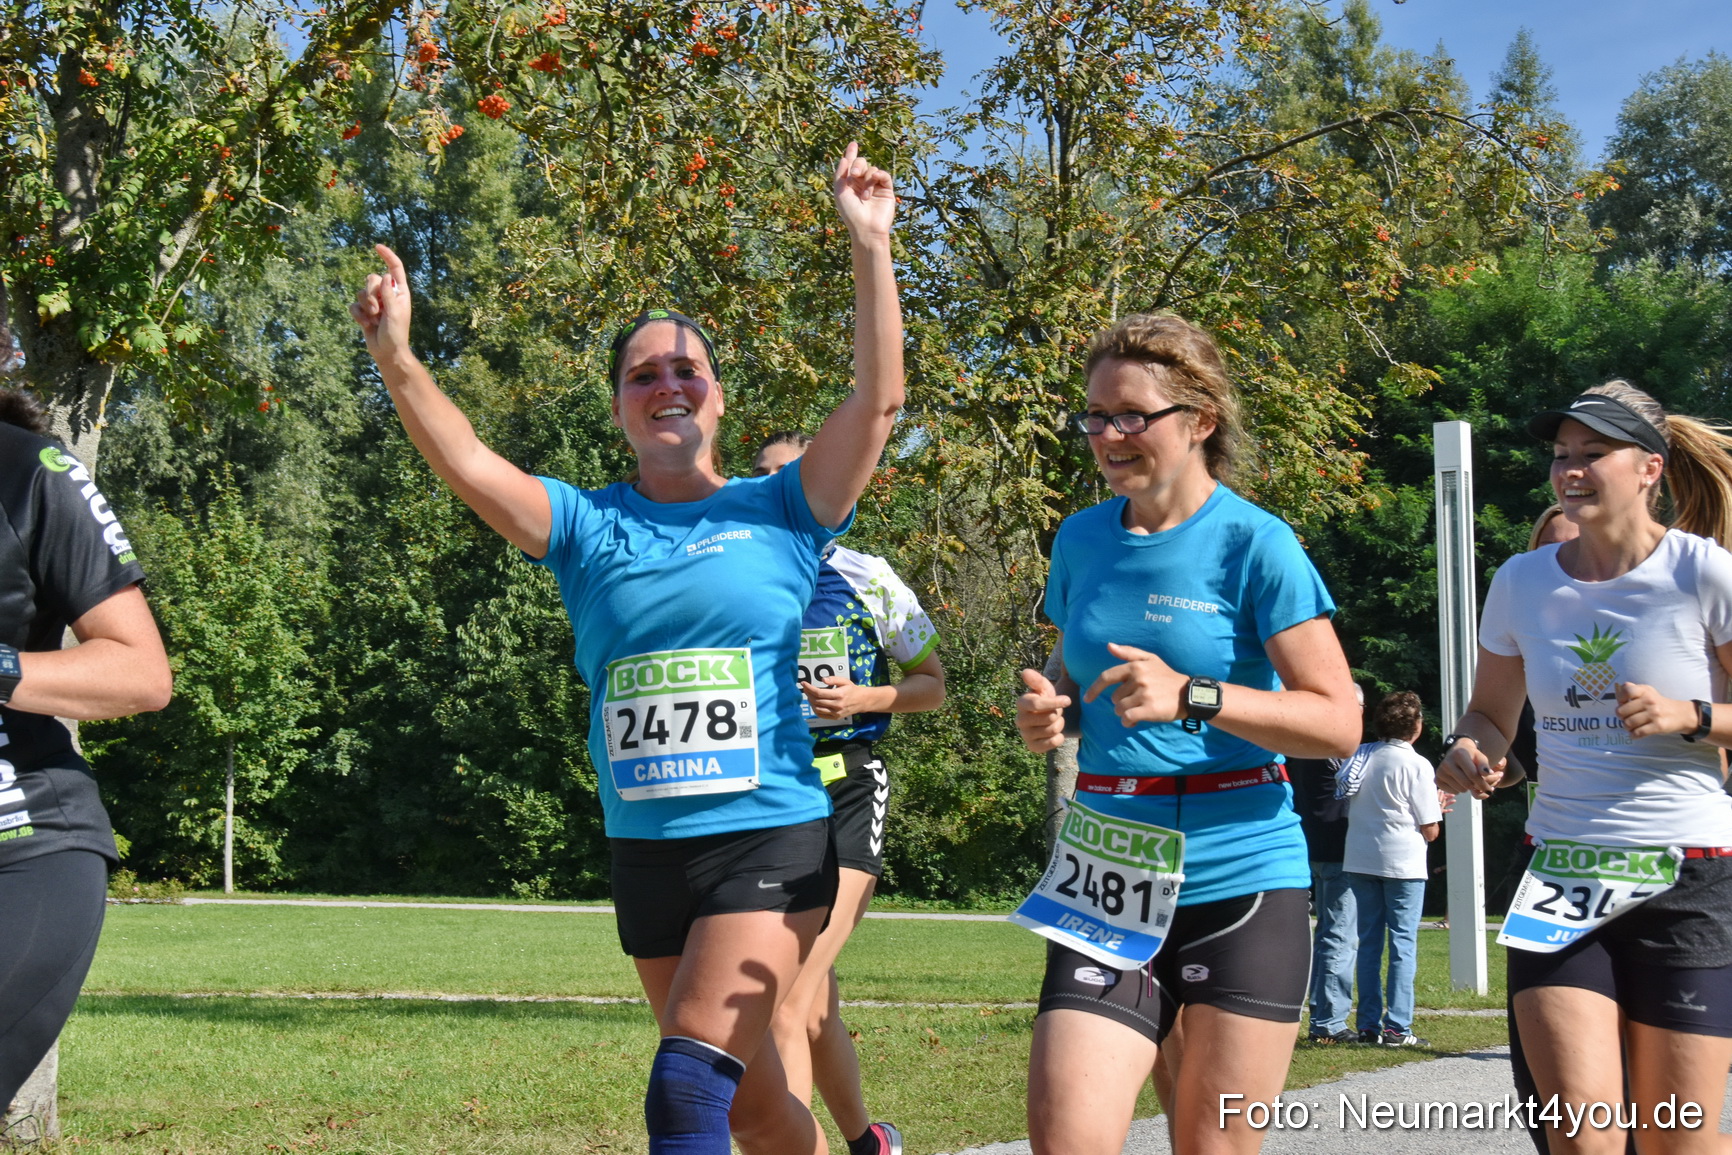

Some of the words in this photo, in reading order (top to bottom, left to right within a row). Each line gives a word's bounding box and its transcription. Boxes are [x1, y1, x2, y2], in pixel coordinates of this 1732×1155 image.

[696, 530, 752, 549] PFLEIDERER
[1158, 595, 1219, 614] PFLEIDERER
[1145, 611, 1172, 623] Irene
[614, 655, 739, 697] BOCK
[740, 701, 748, 709] D
[617, 699, 738, 750] 2478
[1542, 716, 1600, 732] GESUND
[1578, 734, 1601, 747] mit
[1604, 733, 1633, 746] Julia
[634, 757, 722, 782] CARINA
[1232, 778, 1258, 787] balance
[0, 825, 34, 841] ow.de
[1067, 809, 1168, 867] BOCK
[1546, 845, 1664, 879] BOCK
[1056, 853, 1153, 924] 2481
[1162, 887, 1170, 896] D
[1532, 881, 1653, 921] 234
[1056, 912, 1125, 950] IRENE
